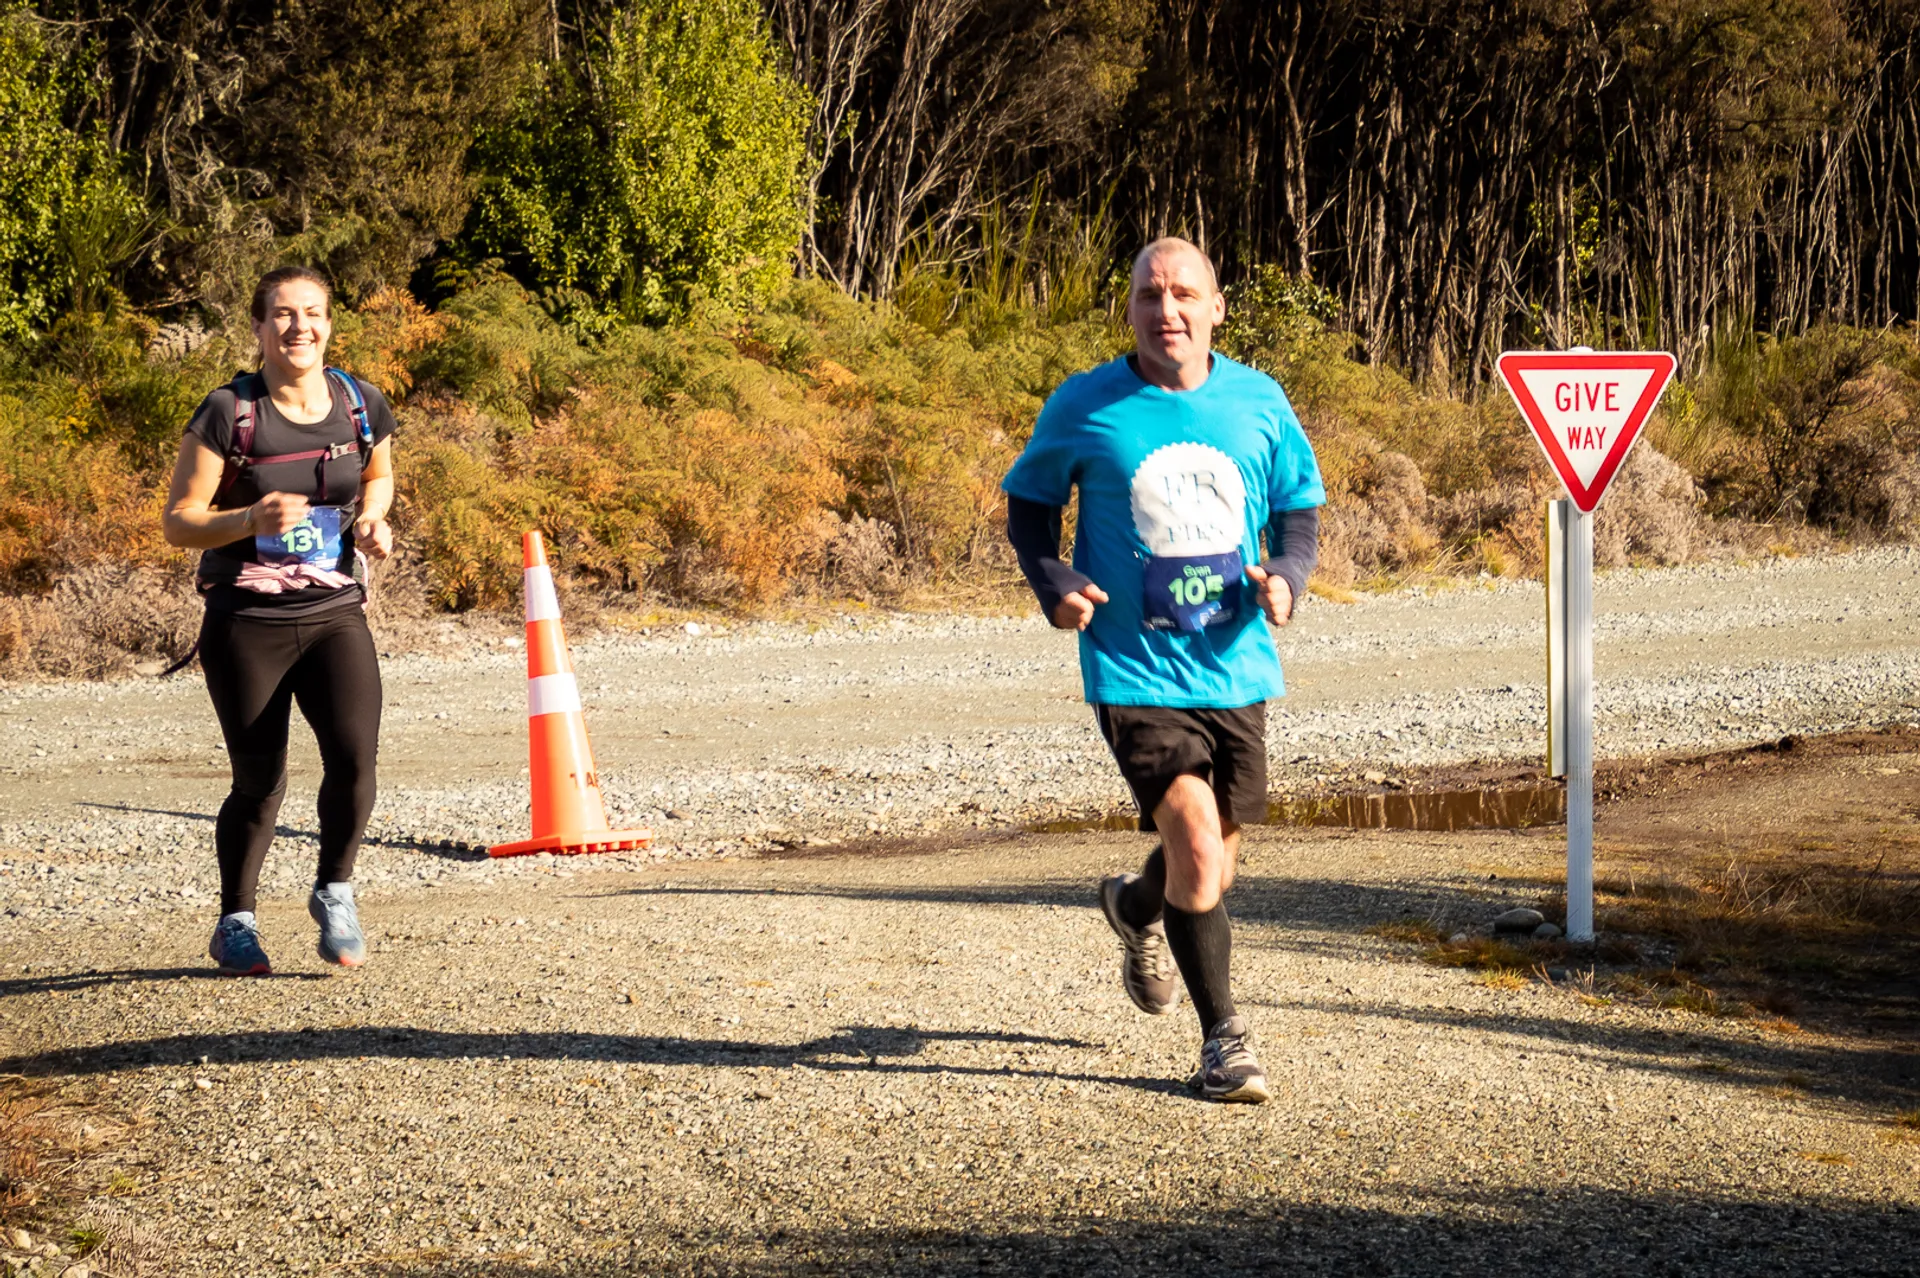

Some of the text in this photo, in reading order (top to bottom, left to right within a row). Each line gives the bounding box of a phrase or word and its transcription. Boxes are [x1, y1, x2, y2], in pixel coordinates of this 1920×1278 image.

[1555, 382, 1620, 412] GIVE
[1567, 426, 1606, 450] WAY
[280, 527, 324, 553] 131
[1168, 574, 1224, 606] 105
